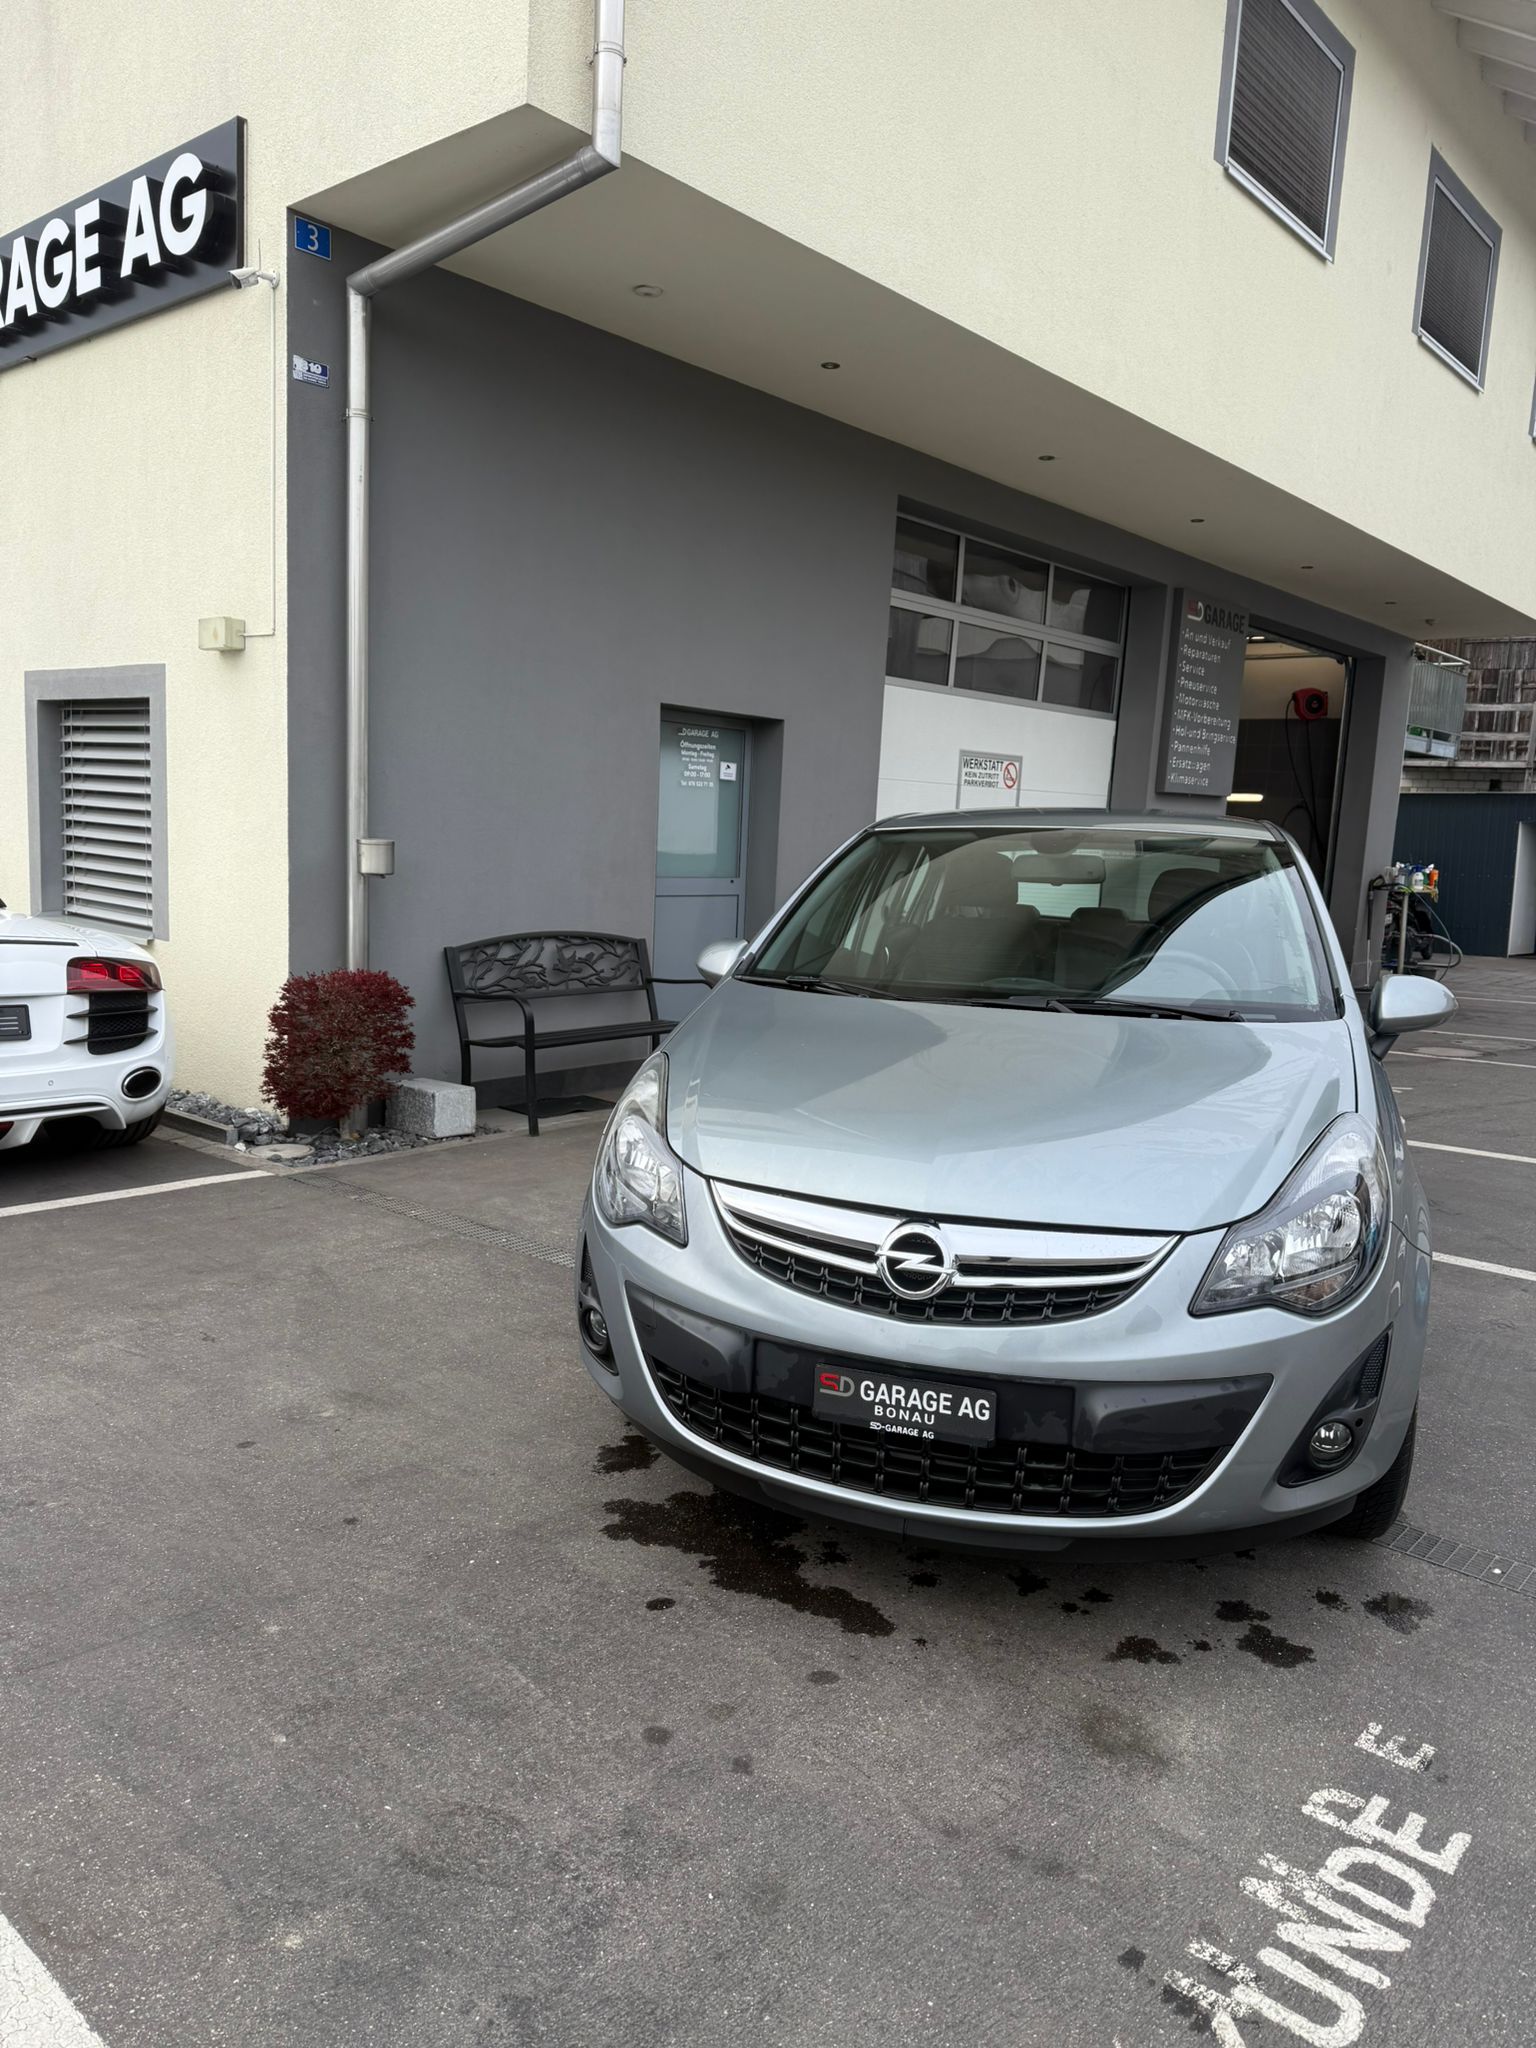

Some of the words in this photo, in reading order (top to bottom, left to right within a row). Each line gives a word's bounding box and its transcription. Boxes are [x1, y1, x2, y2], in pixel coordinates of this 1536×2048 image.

[0, 198, 101, 328] AGE
[121, 153, 207, 278] AG
[307, 224, 319, 252] 3
[1204, 604, 1246, 634] GARAGE
[1195, 632, 1208, 644] und
[1208, 634, 1232, 649] Verkauf
[1183, 644, 1221, 663] Reparaturen
[1181, 660, 1205, 676] Service
[1180, 677, 1218, 695] Pneuservice
[687, 728, 709, 738] GARAGE
[711, 730, 719, 738] AG
[1173, 741, 1211, 756] Pannenhilfe
[962, 757, 1004, 772] WERKSTATT
[963, 779, 999, 788] PARKVERBOT
[964, 771, 978, 779] KEIN
[978, 772, 999, 780] ZUTRITT
[1170, 772, 1209, 787] Klimaservice
[819, 1372, 855, 1397] SD
[859, 1380, 953, 1415] GARAGE
[958, 1396, 990, 1421] AG
[874, 1404, 935, 1425] BONAU
[869, 1421, 919, 1437] SD-GARAGE
[922, 1430, 935, 1440] AG
